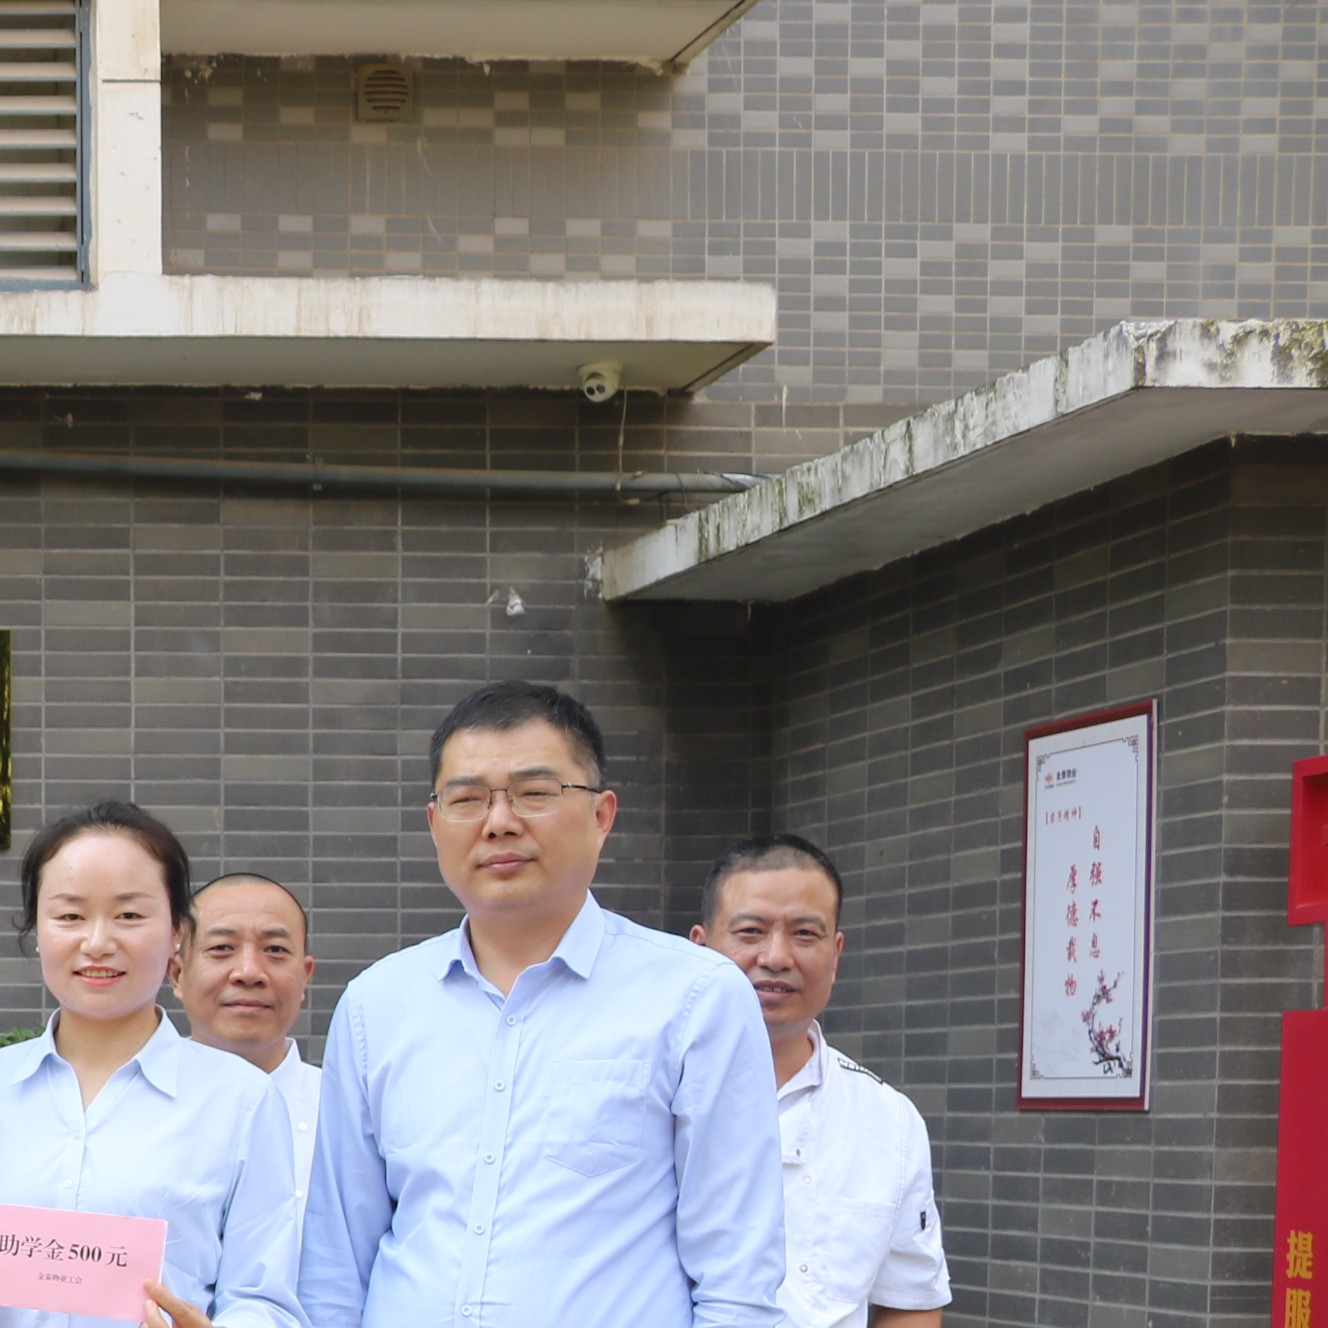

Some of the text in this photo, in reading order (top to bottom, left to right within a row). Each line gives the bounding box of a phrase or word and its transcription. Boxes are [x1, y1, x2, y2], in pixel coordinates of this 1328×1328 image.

[1064, 863, 1079, 997] 厚德载物
[1089, 825, 1102, 958] 自强不息
[37, 1272, 83, 1285] 金泰物业工会
